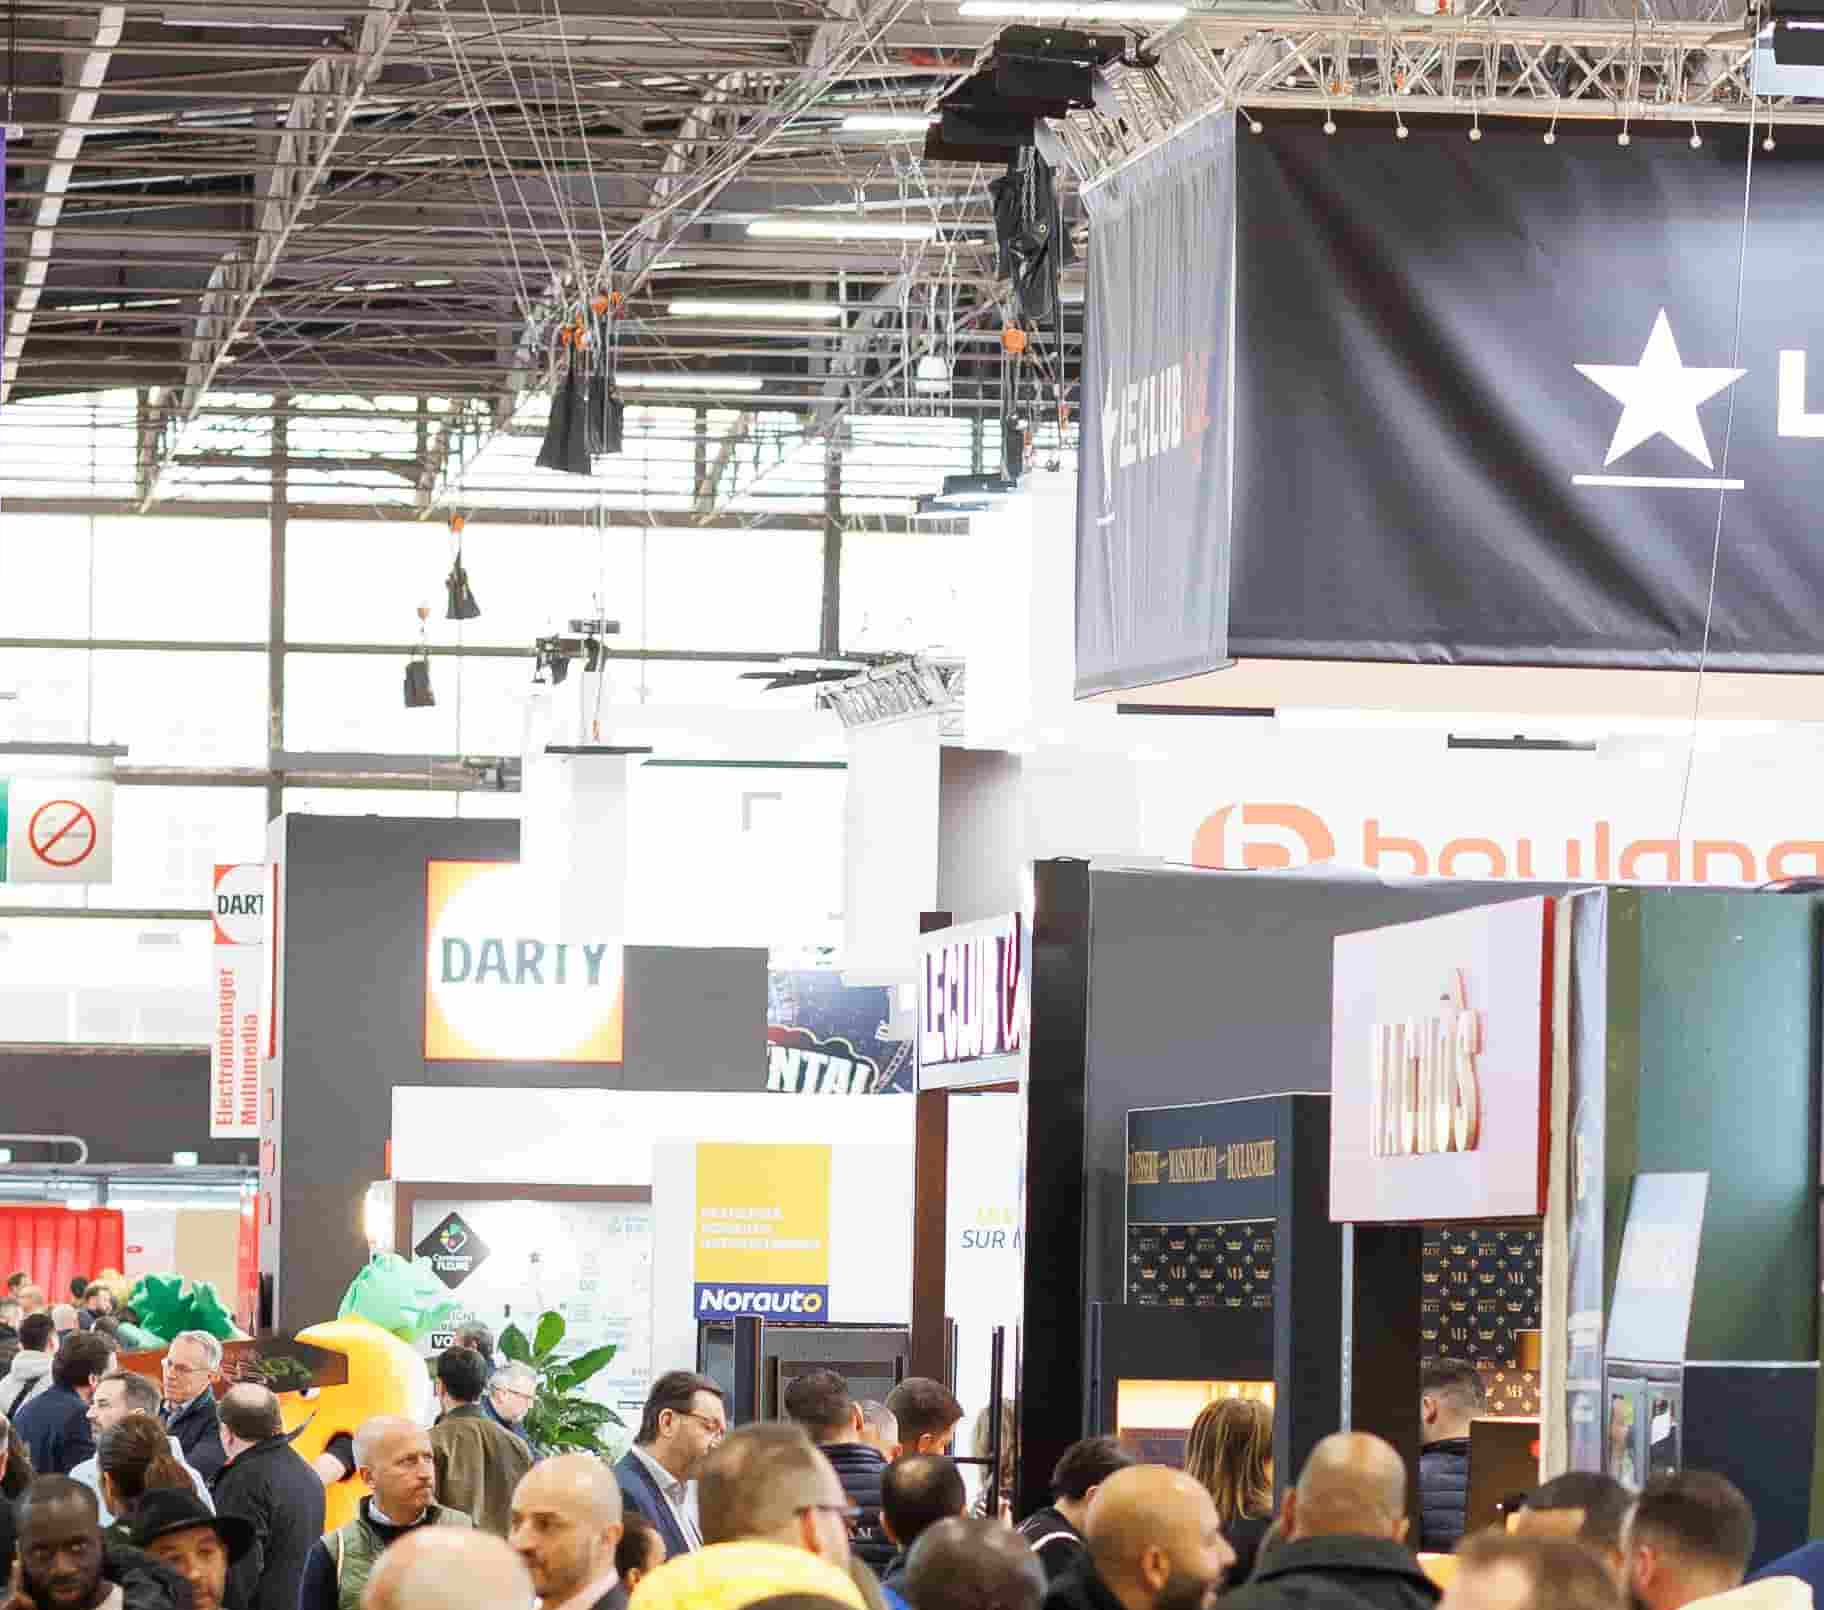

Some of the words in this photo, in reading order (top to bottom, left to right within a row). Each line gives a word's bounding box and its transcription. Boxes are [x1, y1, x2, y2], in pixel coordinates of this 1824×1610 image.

[217, 894, 265, 915] DART
[440, 937, 608, 985] DARTY
[960, 1228, 1006, 1249] SUR
[699, 1288, 823, 1313] Norauto
[433, 1333, 457, 1348] VO
